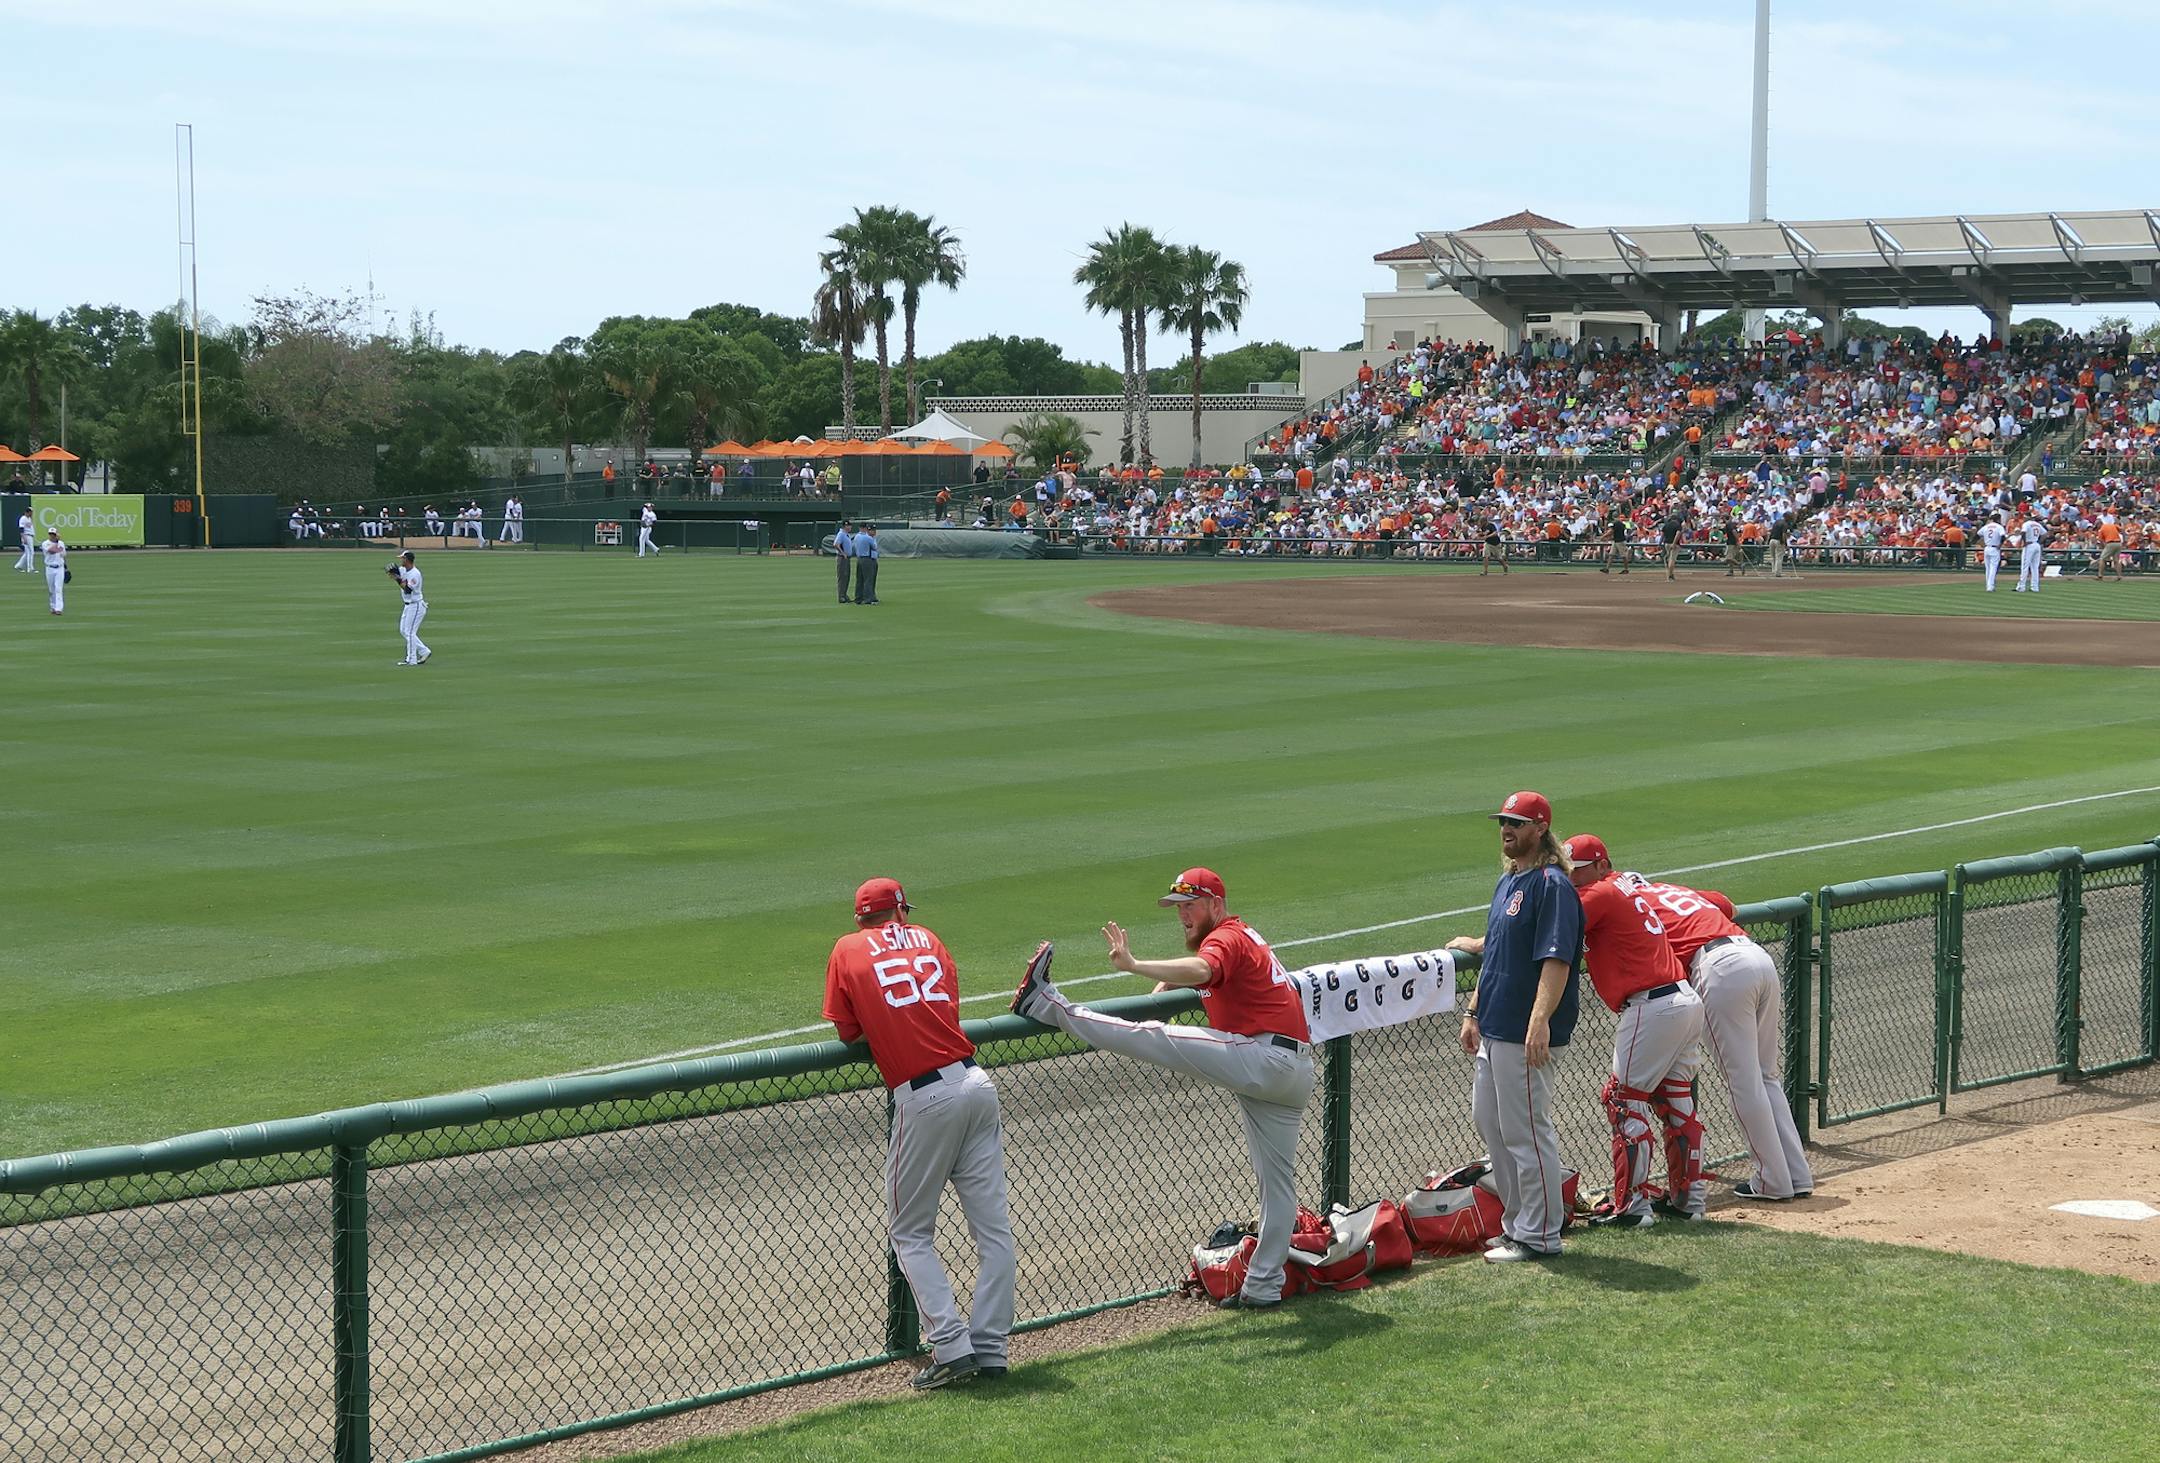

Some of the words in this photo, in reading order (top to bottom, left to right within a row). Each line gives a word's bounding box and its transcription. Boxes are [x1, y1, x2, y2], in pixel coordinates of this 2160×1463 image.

[173, 499, 192, 513] 339
[1506, 890, 1524, 917] B
[867, 927, 931, 956] J.SMITH
[1355, 963, 1370, 983] G
[1385, 959, 1399, 979] G
[1413, 954, 1429, 972] G
[873, 956, 950, 1007] 52
[1326, 969, 1341, 991] G
[1402, 978, 1416, 1001] G
[1345, 988, 1359, 1012] G
